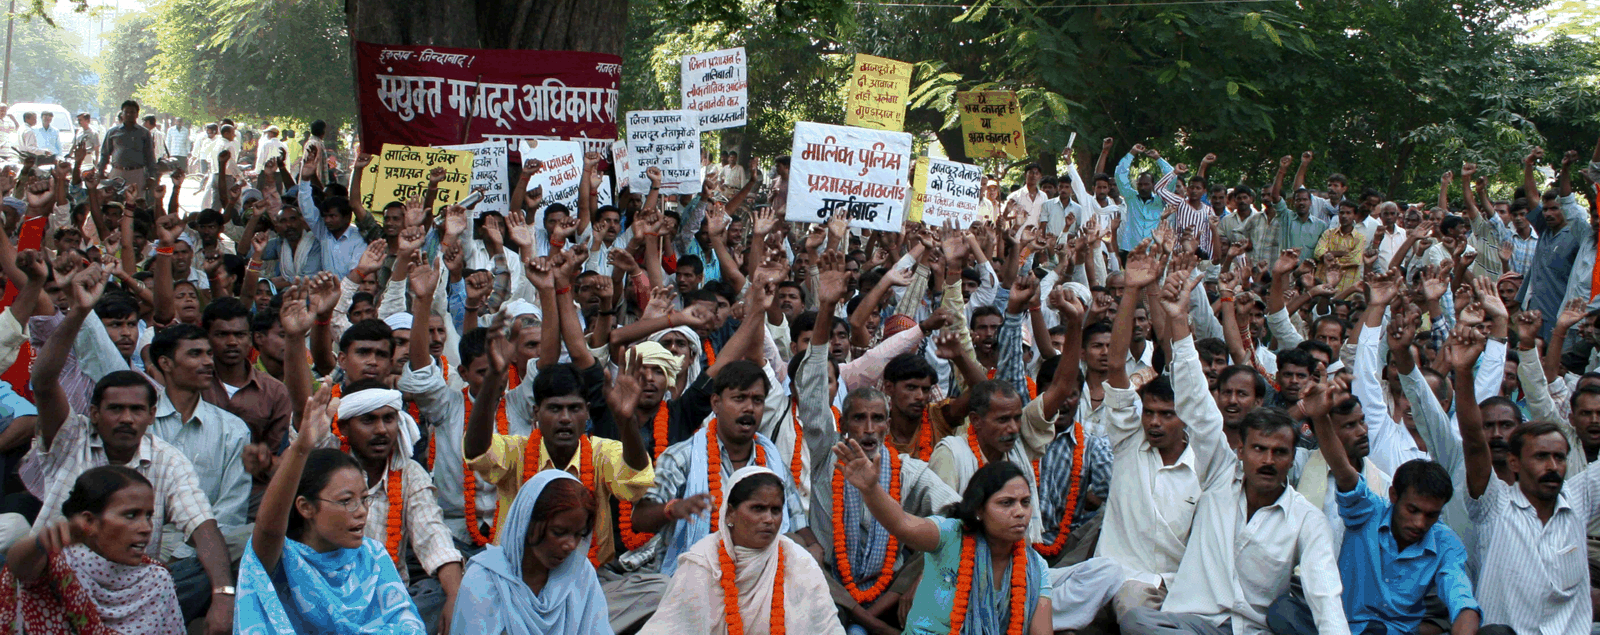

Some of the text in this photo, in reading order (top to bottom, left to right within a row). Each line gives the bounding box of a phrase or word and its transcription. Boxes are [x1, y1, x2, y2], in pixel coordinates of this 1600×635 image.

[376, 66, 445, 122] संयुक्त
[518, 77, 605, 123] अधिकार
[629, 113, 682, 125] जिला प्रशासन
[980, 118, 991, 129] या
[425, 148, 460, 166] पुलिस
[801, 135, 902, 177] मालिक पुलिस
[384, 166, 425, 180] प्रशासन
[807, 173, 863, 196] प्रशासन
[930, 175, 981, 199] को रिहा करो
